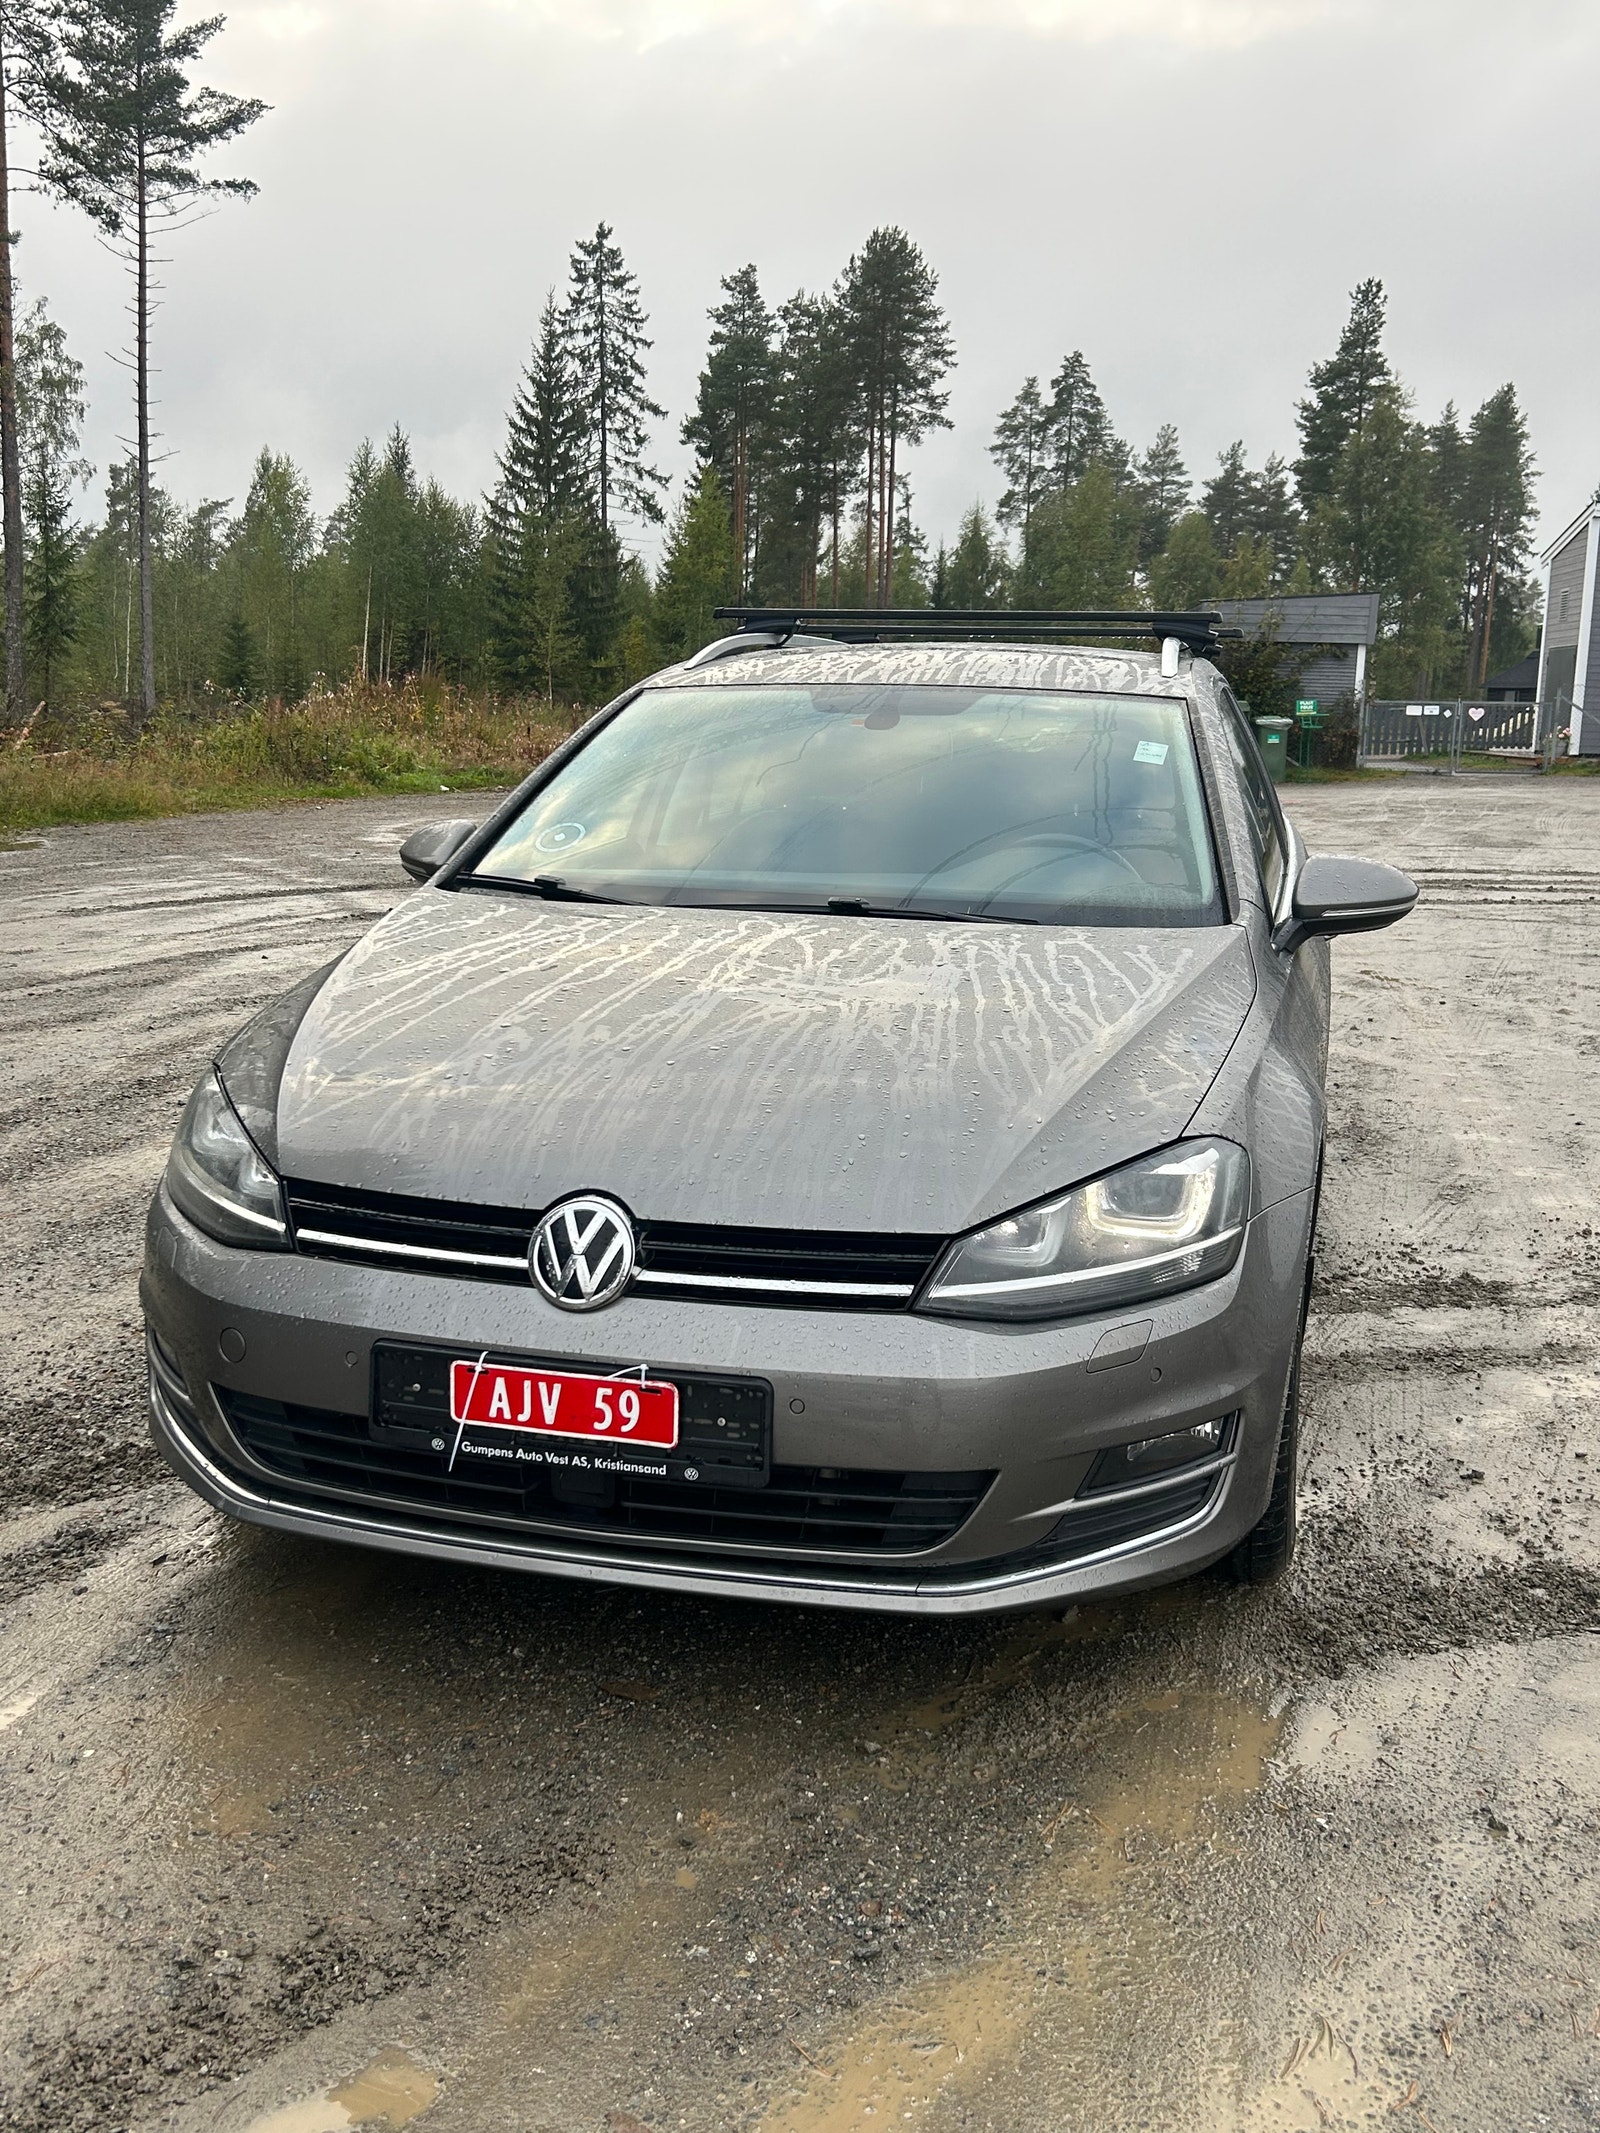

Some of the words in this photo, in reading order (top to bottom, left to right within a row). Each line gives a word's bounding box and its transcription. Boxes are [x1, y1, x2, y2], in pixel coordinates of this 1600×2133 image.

[488, 1376, 562, 1425] AJV
[592, 1387, 641, 1433] 59
[460, 1441, 513, 1458] Gumpens
[515, 1448, 543, 1462] Auto
[544, 1451, 569, 1465] Vest
[571, 1455, 591, 1469] AS,
[594, 1457, 667, 1476] Kristiansand
